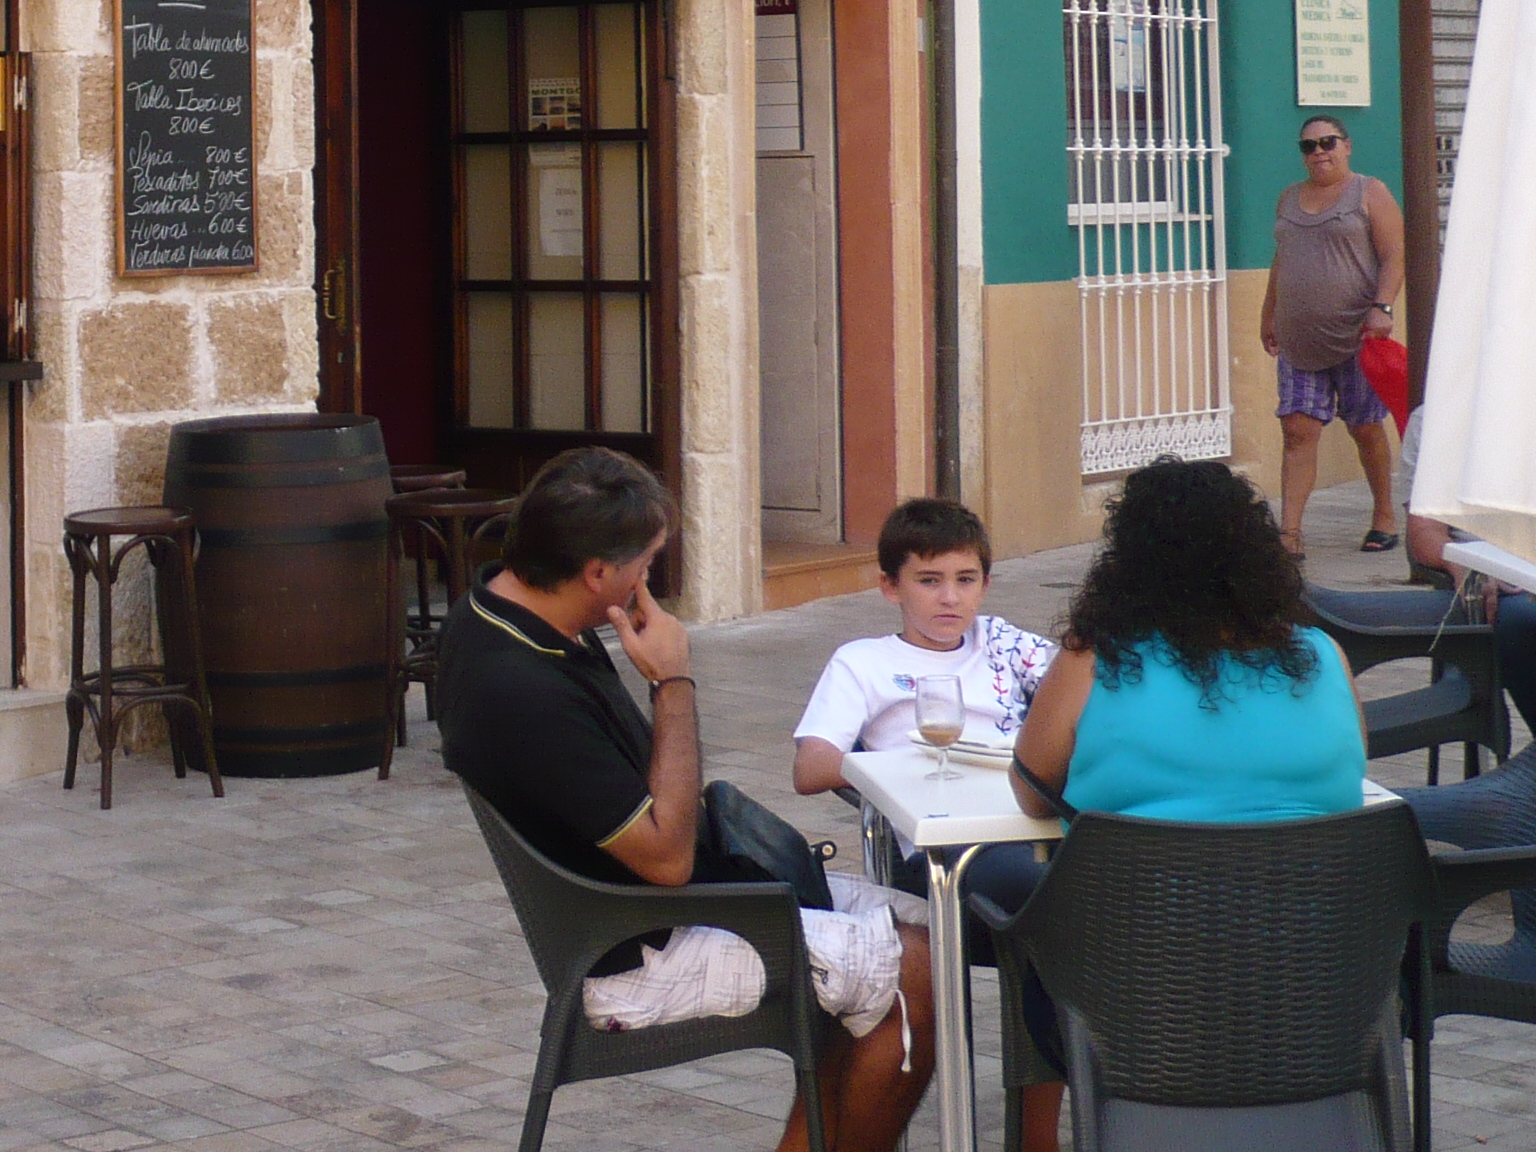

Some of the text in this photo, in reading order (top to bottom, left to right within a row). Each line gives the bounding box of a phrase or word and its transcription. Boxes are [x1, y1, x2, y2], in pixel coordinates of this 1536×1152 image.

[124, 15, 171, 58] Tabla
[176, 30, 191, 50] de
[127, 80, 172, 111] Tabla
